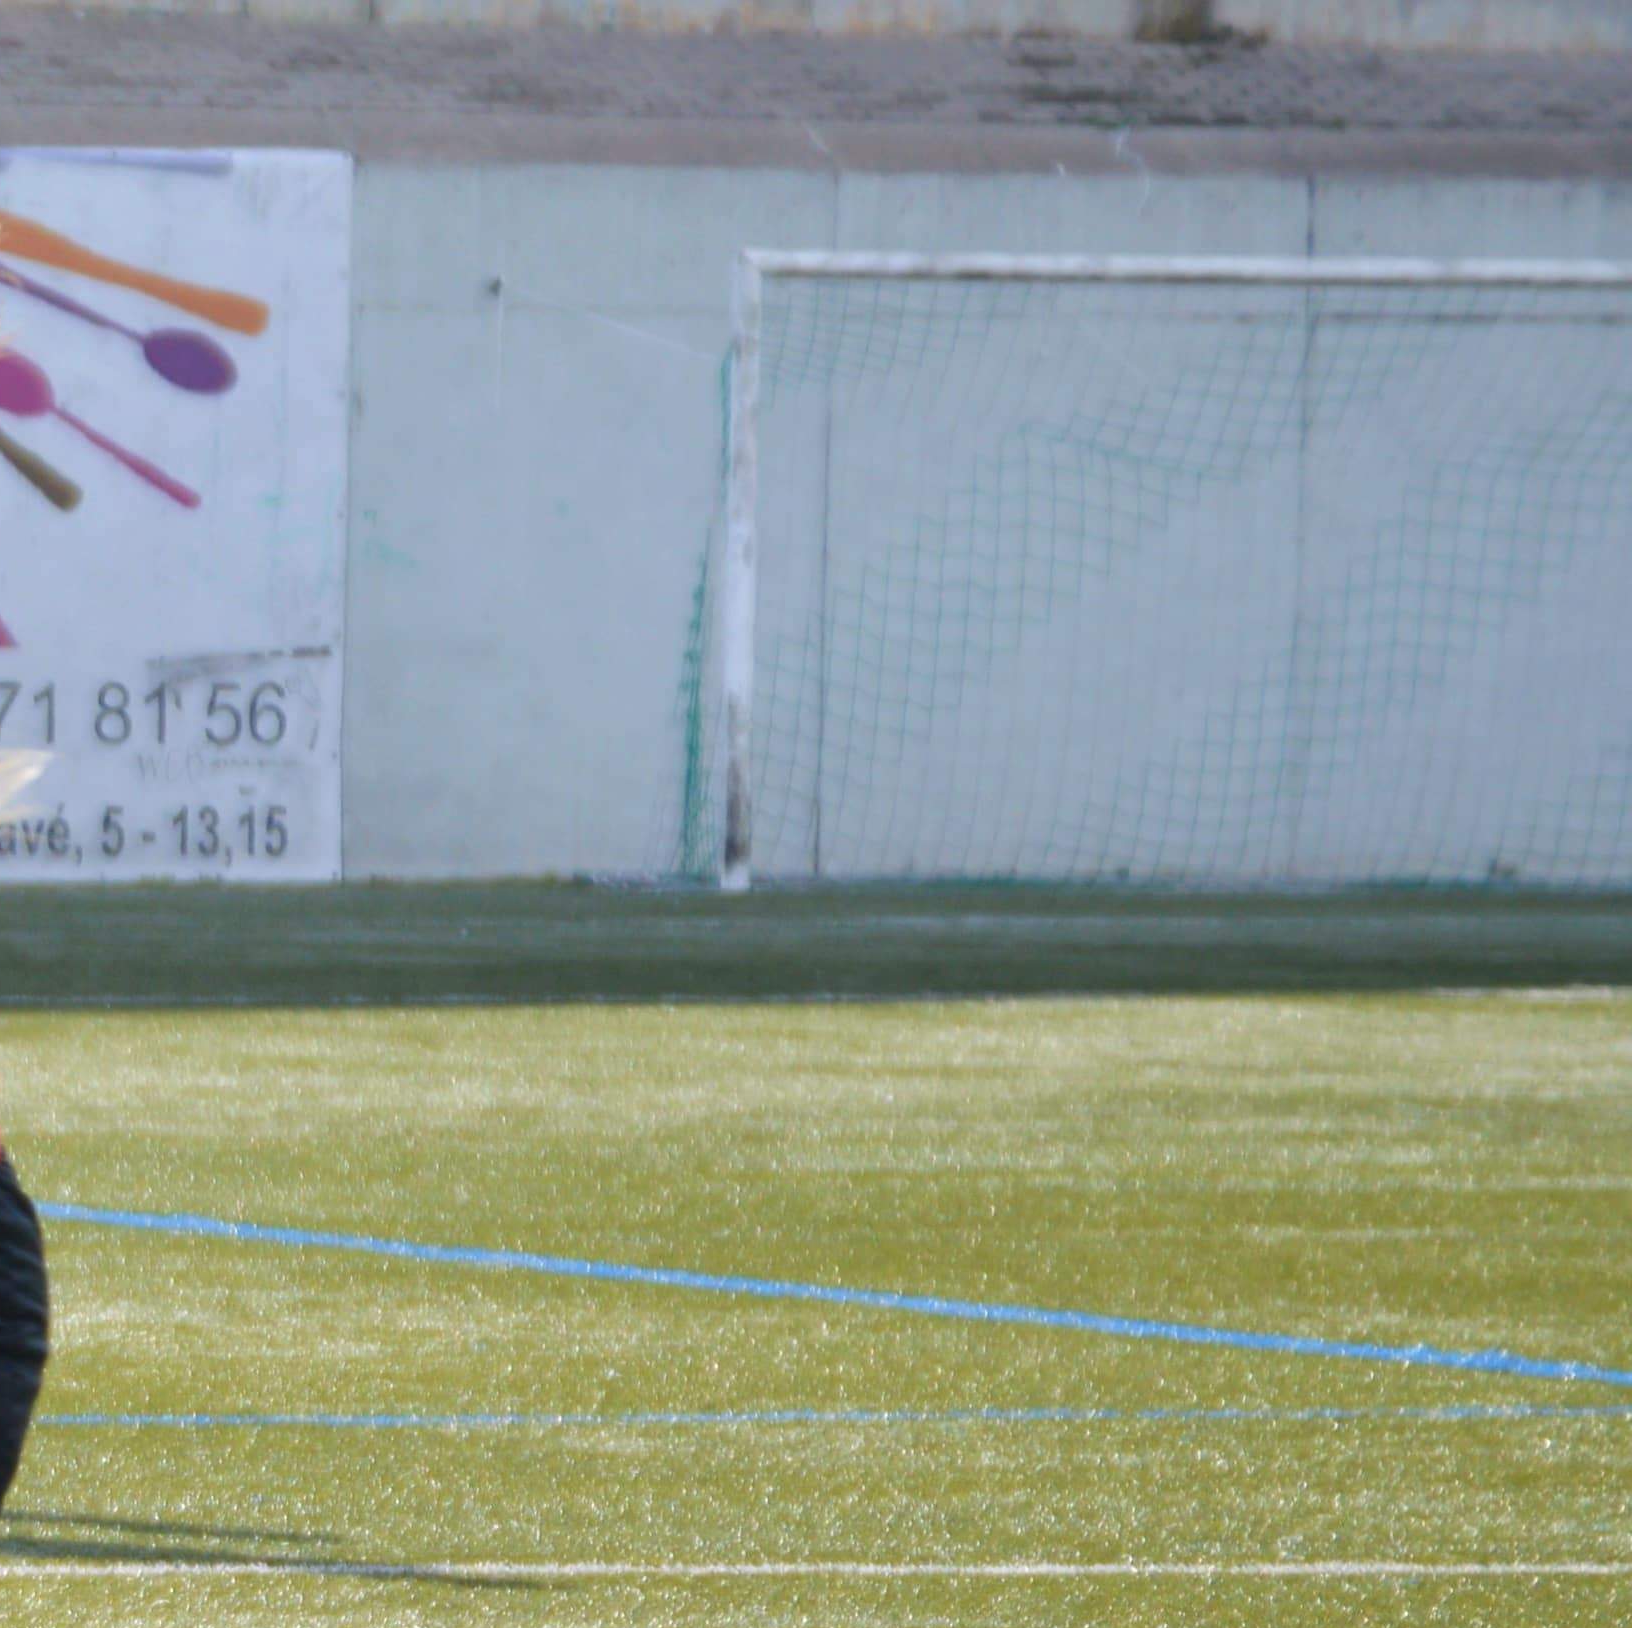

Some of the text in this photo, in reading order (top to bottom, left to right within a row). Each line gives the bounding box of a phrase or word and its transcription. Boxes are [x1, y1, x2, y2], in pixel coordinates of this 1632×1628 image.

[92, 680, 169, 747] 81
[204, 680, 288, 748] 56
[95, 804, 127, 861] 5
